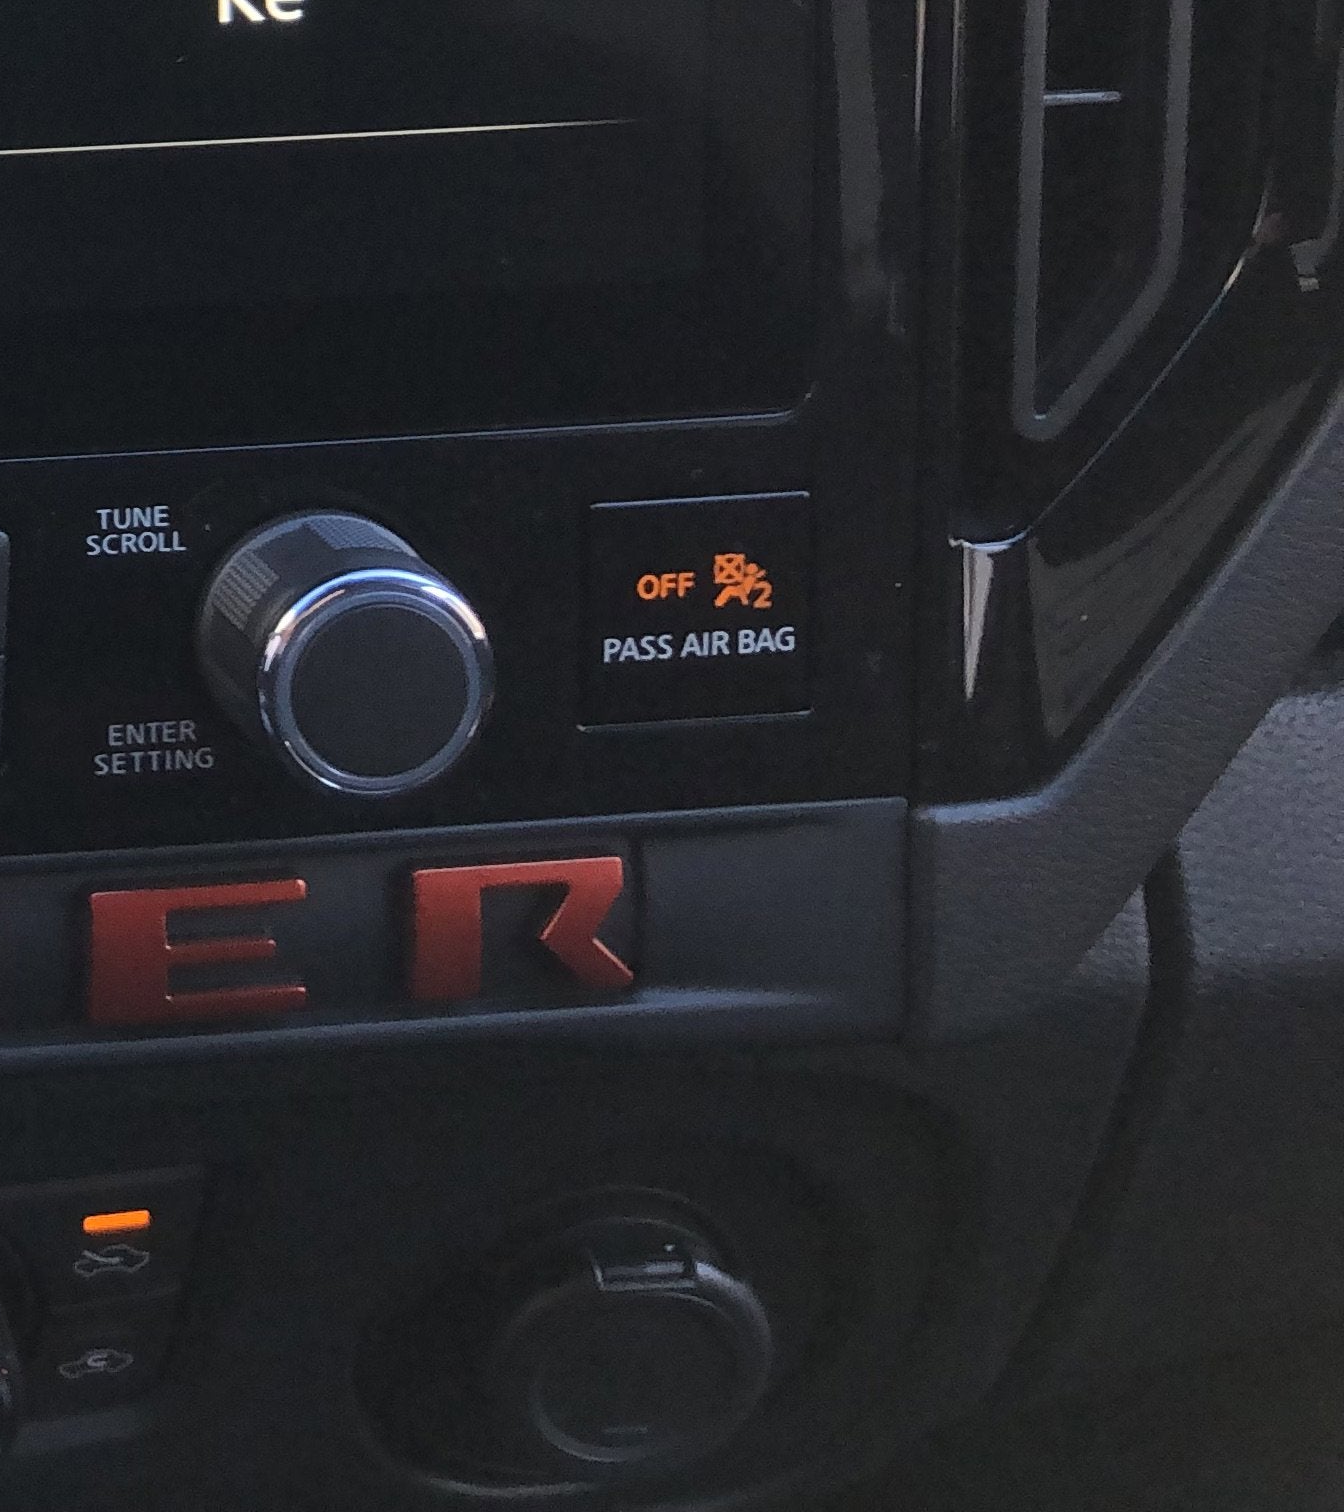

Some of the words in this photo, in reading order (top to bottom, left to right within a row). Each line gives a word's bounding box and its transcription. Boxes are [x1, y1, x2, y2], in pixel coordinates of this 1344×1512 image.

[96, 505, 170, 531] TUNE
[86, 527, 187, 555] SCROLL
[636, 572, 696, 600] OFF
[603, 634, 673, 663] PASS
[680, 630, 730, 658] AIR
[737, 626, 796, 654] BAG
[107, 719, 196, 746] ENTER
[93, 747, 215, 776] SETTING
